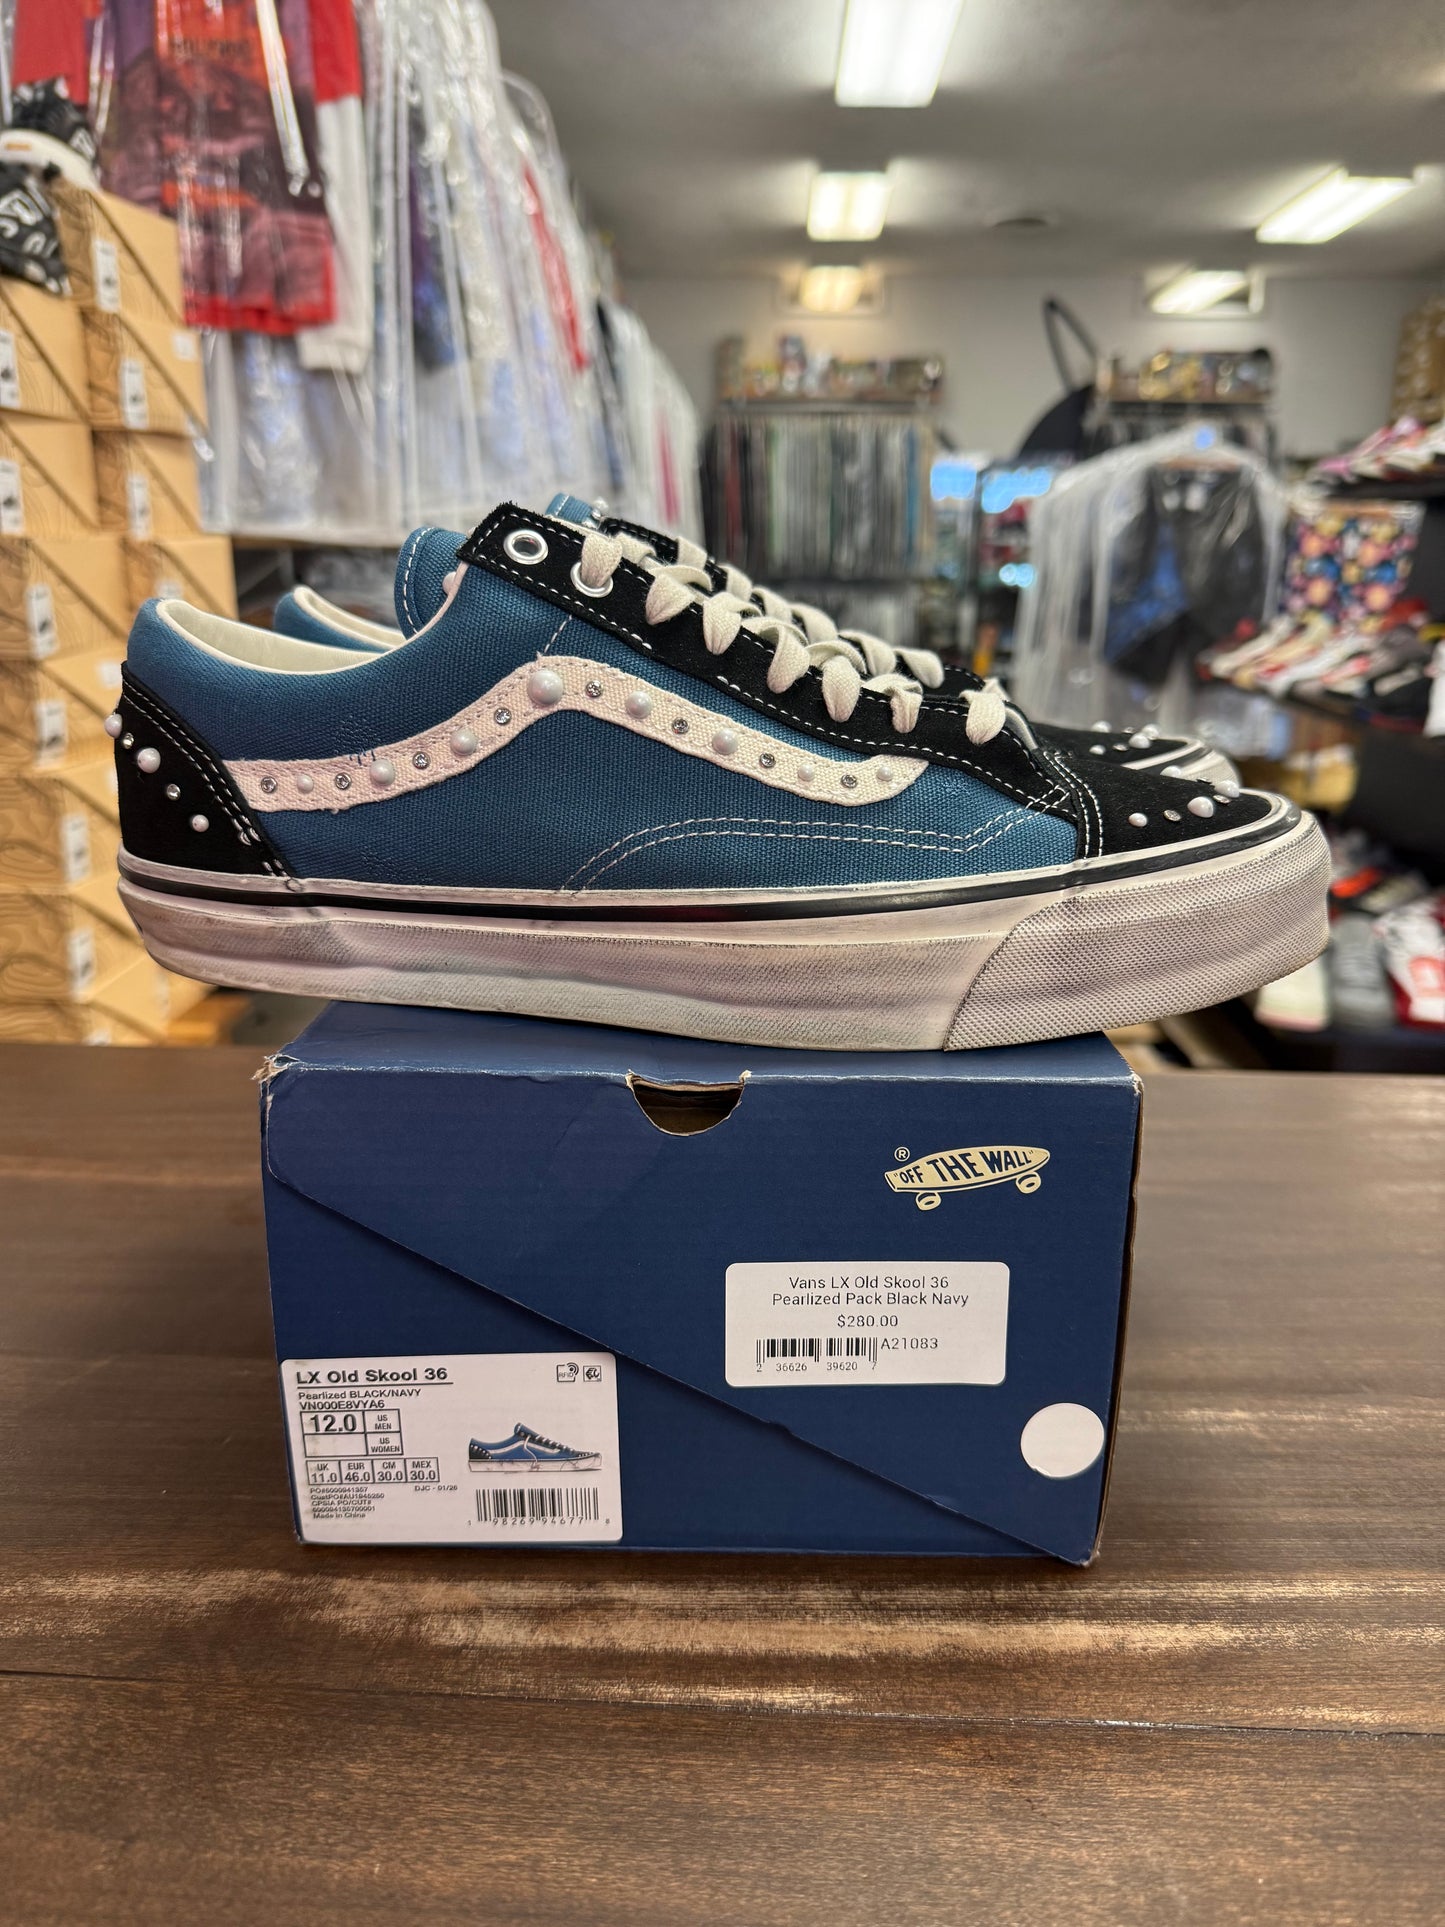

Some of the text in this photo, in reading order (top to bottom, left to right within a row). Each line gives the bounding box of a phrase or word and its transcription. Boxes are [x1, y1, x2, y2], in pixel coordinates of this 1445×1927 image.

[926, 1153, 984, 1182] THE
[789, 1276, 949, 1289] Vans LX Old Skool 36
[773, 1293, 968, 1307] Pearlized Pack Black Navy
[837, 1315, 898, 1328] $280.00
[881, 1338, 938, 1349] A21083
[756, 1361, 877, 1373] 2 36626 39620 7
[297, 1368, 448, 1384] LX Old Skool 36
[299, 1389, 421, 1400] Pearlized BLACK/NAVY
[300, 1400, 385, 1410] VN000E8VYA6
[310, 1414, 356, 1433] 12.0
[311, 1473, 337, 1482] 11.0
[345, 1472, 370, 1481] 46.0
[378, 1471, 403, 1481] 30.0
[410, 1470, 435, 1480] 30.0
[493, 1518, 535, 1526] 98269
[542, 1517, 584, 1525] 94677
